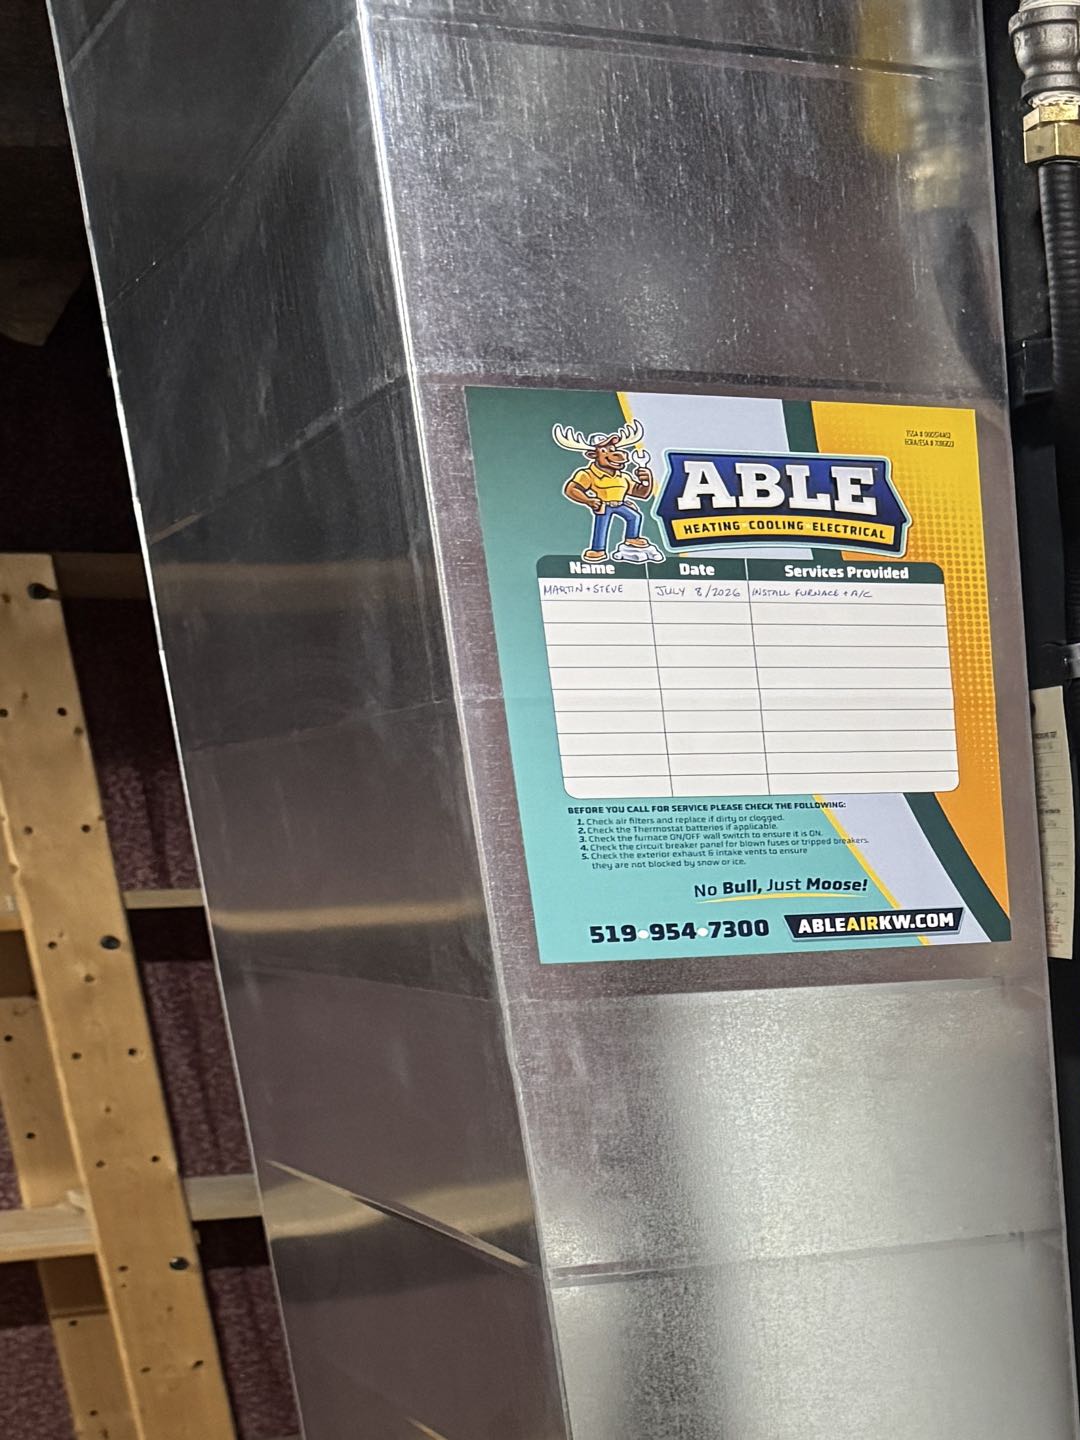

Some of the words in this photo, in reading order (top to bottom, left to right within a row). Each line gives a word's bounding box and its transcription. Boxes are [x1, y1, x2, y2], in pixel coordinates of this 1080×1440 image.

[677, 460, 877, 516] ABLE
[684, 521, 740, 535] HEATING
[749, 520, 804, 531] COOLING
[812, 522, 886, 540] ELECTRICAL
[569, 562, 615, 575] Name
[680, 564, 715, 576] Date
[784, 564, 844, 579] Services
[848, 566, 909, 580] Provided
[543, 583, 583, 595] MARTIN
[593, 583, 623, 594] STEVE
[654, 586, 686, 598] JULY
[568, 806, 604, 814] BEFORE
[627, 805, 650, 813] CALL
[672, 804, 708, 812] SERVICE
[586, 817, 614, 825] Check
[616, 817, 627, 825] air
[629, 816, 655, 824] filters
[657, 816, 672, 824] and
[675, 816, 706, 825] replace
[716, 815, 736, 823] dirty
[750, 815, 784, 823] clogged.
[694, 884, 717, 898] No
[723, 880, 762, 895] Bull,
[766, 878, 802, 893] Just
[806, 878, 867, 892] Moose!
[798, 912, 954, 935] ABLEAIRKW.COM
